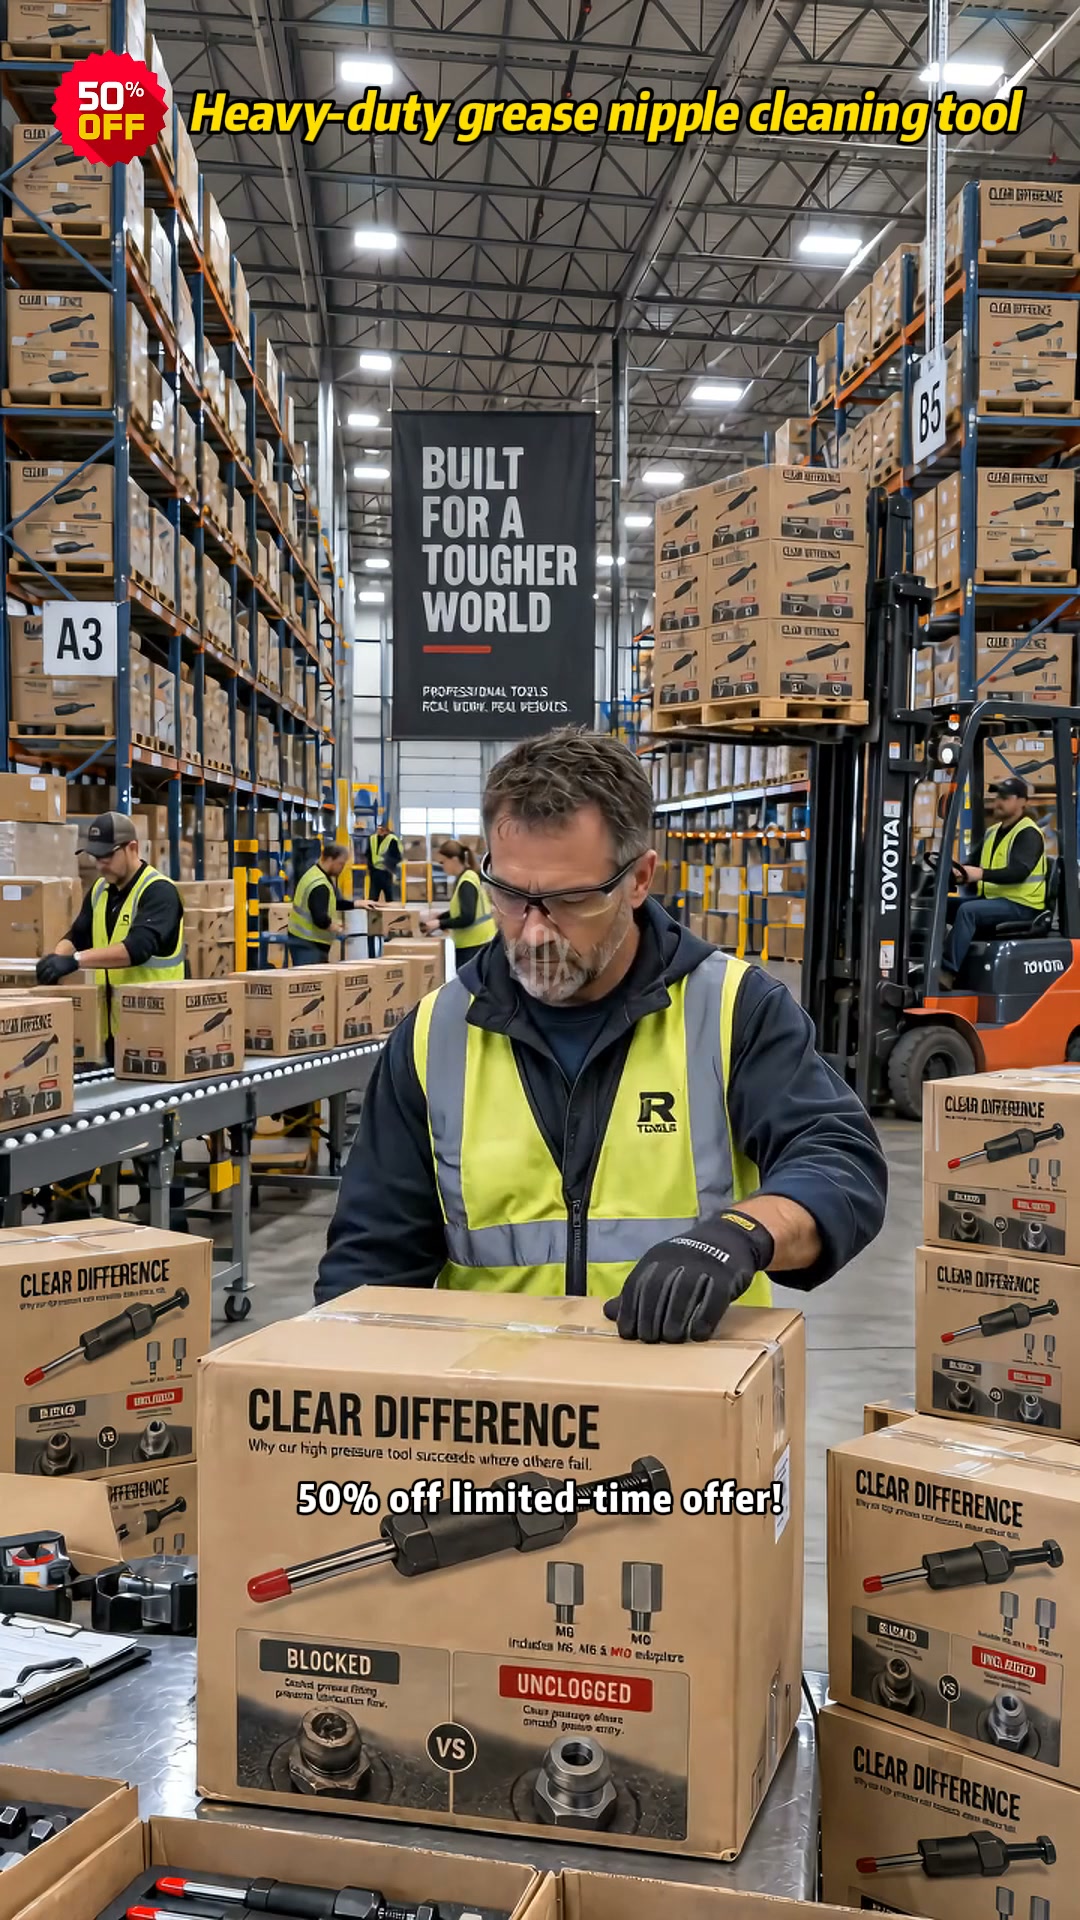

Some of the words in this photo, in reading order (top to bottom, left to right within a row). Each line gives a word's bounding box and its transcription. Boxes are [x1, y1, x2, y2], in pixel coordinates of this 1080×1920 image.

[920, 380, 941, 443] B5
[422, 446, 524, 490] BUILT
[422, 496, 490, 538] FOR
[499, 496, 524, 539] A
[422, 544, 578, 586] TOUGHER
[422, 591, 551, 633] WORLD
[57, 617, 103, 661] A3
[881, 819, 900, 915] TOYOTA
[637, 1091, 677, 1122] R
[20, 1269, 73, 1298] CLEAR
[77, 1258, 171, 1292] DIFFERENCE
[249, 1388, 363, 1437] CLEAR
[375, 1394, 600, 1449] DIFFERENCE
[249, 1438, 276, 1455] Why
[388, 1447, 412, 1460] tool
[569, 1456, 593, 1471] fail.
[855, 1469, 910, 1503] CLEAR
[915, 1481, 1024, 1528] DIFFERENCE
[287, 1647, 372, 1676] BLOCKED
[518, 1673, 631, 1704] UNCLOGGED
[436, 1736, 466, 1761] VS
[853, 1745, 908, 1787] CLEAR
[913, 1763, 1021, 1822] DIFFERENCE
